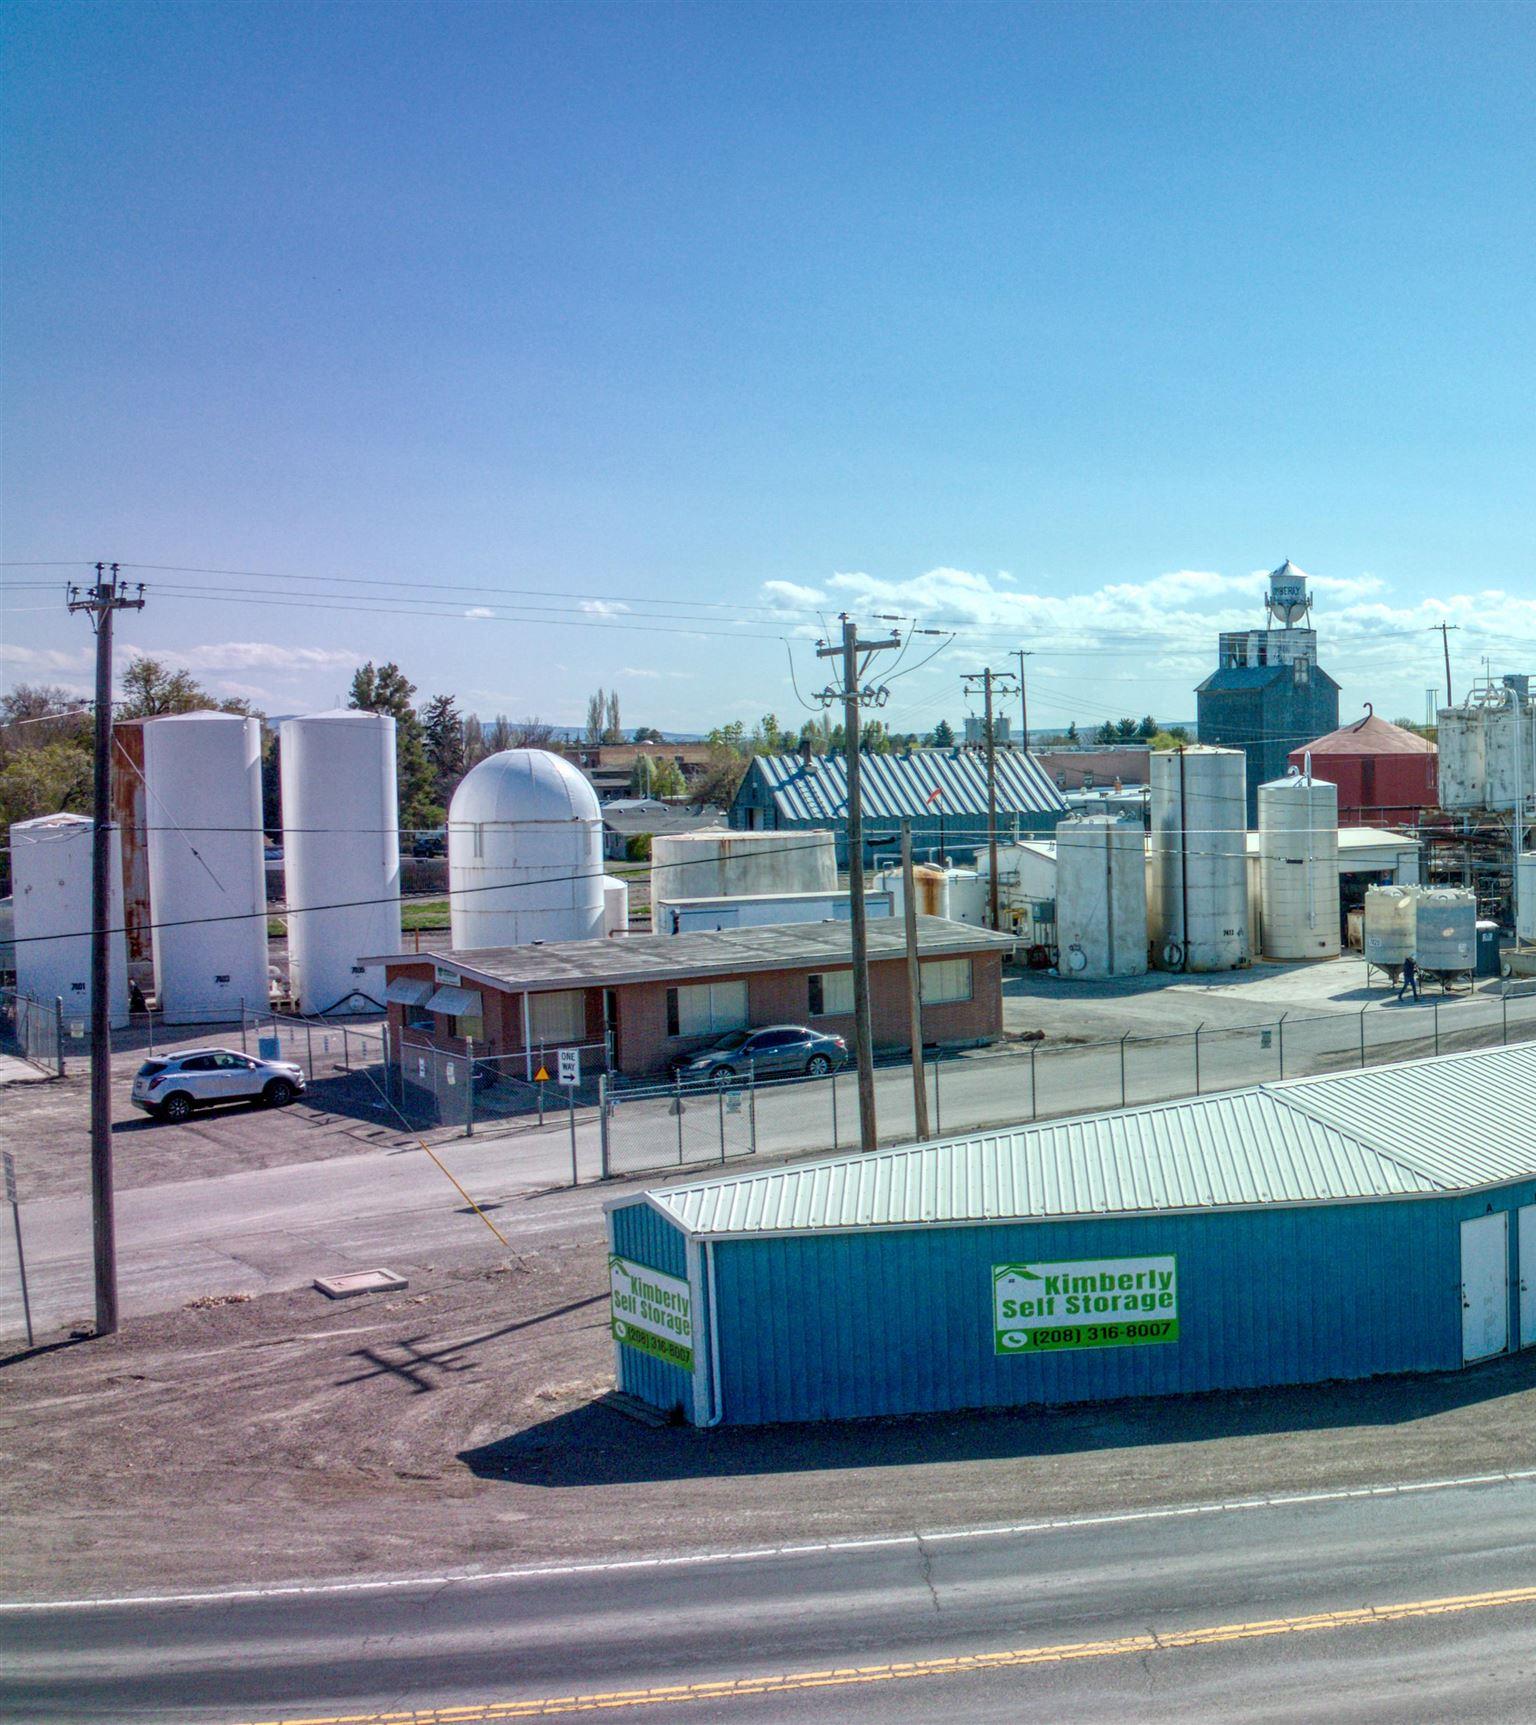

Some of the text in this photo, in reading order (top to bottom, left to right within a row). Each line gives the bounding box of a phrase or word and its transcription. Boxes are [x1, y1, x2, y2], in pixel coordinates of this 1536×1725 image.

[561, 1052, 576, 1061] ONE
[562, 1062, 576, 1071] WAY
[1045, 1269, 1173, 1295] Kimberly
[630, 1275, 689, 1318] Kimberly
[1002, 1290, 1174, 1318] Self Storage
[614, 1289, 691, 1336] Self Storage
[1033, 1322, 1171, 1346] (208) 316-8007
